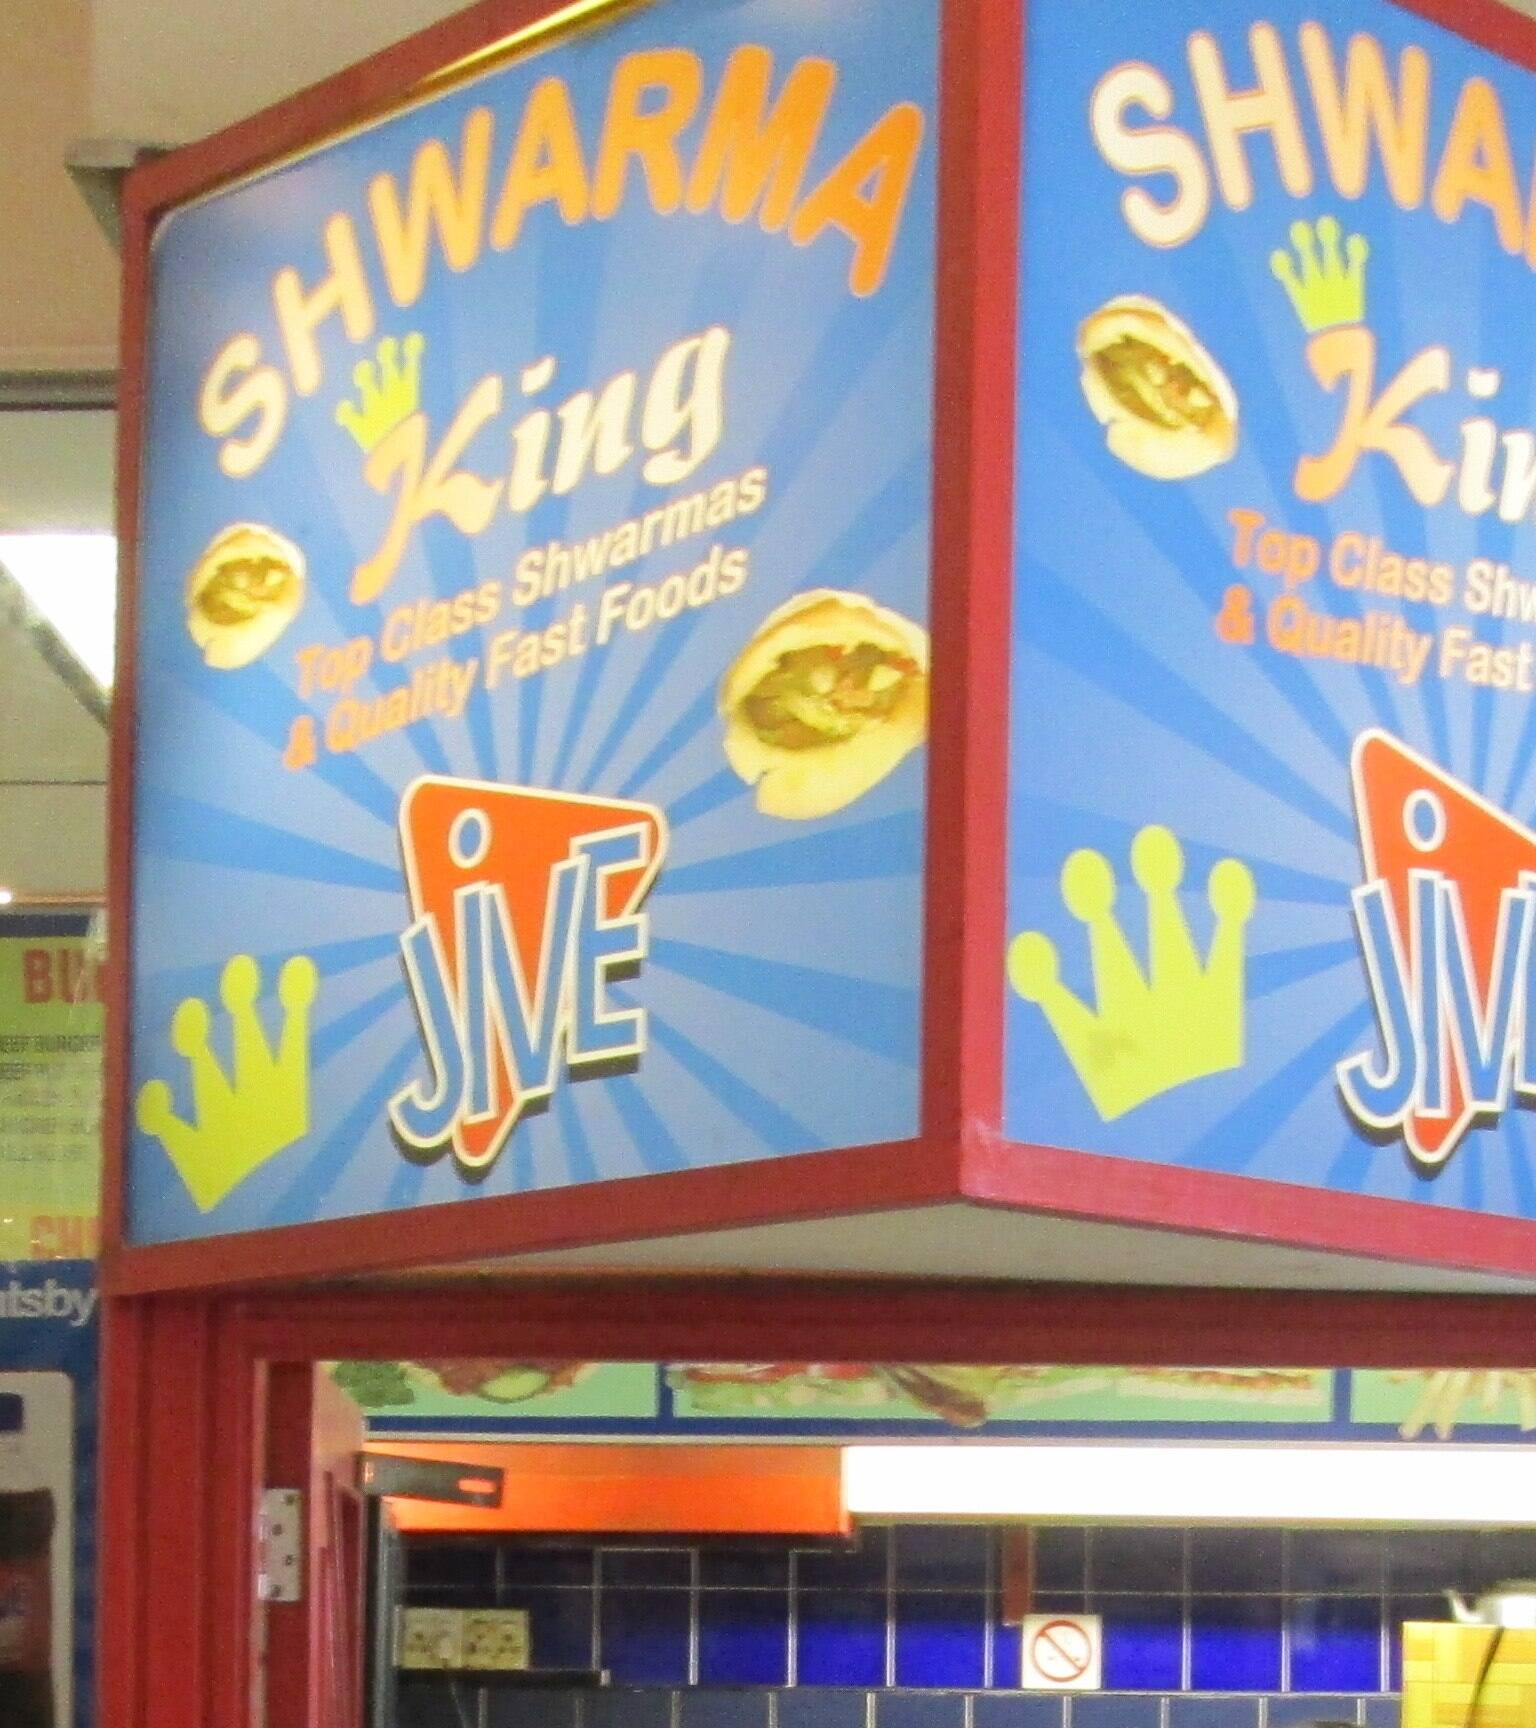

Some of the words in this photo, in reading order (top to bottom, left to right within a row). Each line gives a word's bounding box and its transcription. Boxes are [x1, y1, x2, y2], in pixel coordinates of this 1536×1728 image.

[198, 44, 925, 478] SHWARMA
[350, 325, 732, 605] King
[1227, 508, 1319, 590] Top
[1330, 530, 1452, 606] Class
[283, 716, 317, 771] &
[325, 656, 479, 756] Quality
[487, 613, 586, 691] Fast
[596, 544, 749, 645] Foods
[294, 634, 372, 702] Top
[381, 579, 501, 665] Class
[513, 466, 769, 605] Shwarmas
[1216, 584, 1254, 645] &
[1268, 594, 1432, 686] Quality
[1440, 626, 1533, 694] Fast
